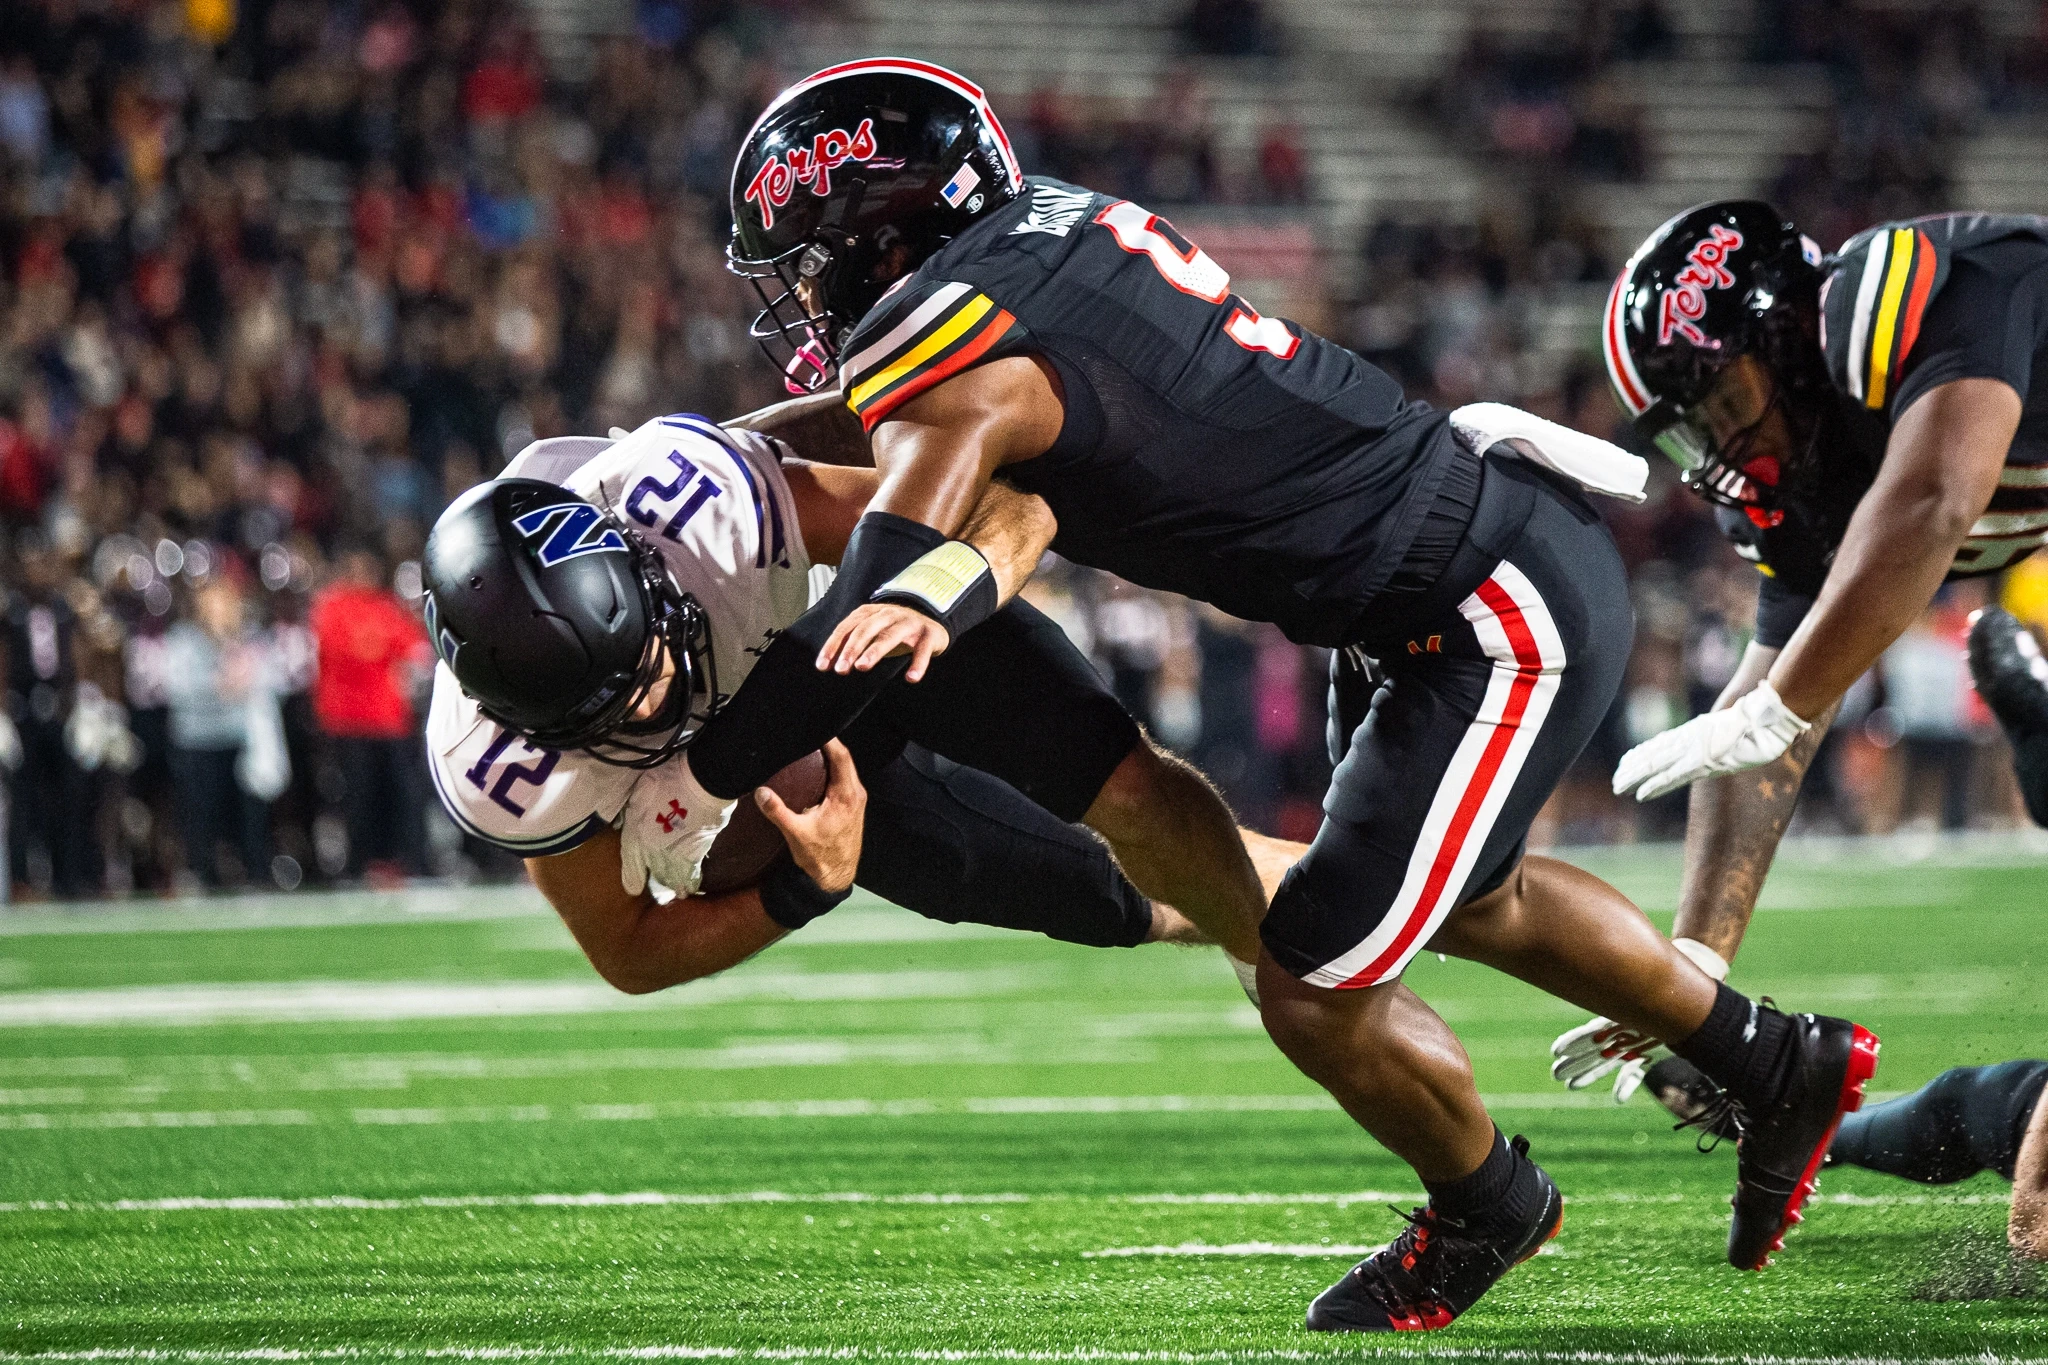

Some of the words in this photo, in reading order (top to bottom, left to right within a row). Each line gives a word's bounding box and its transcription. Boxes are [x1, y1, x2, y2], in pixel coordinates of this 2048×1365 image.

[744, 118, 877, 230] Terps
[1658, 223, 1744, 346] Terps
[511, 502, 630, 568] N
[625, 449, 723, 543] 12
[465, 729, 561, 819] 12
